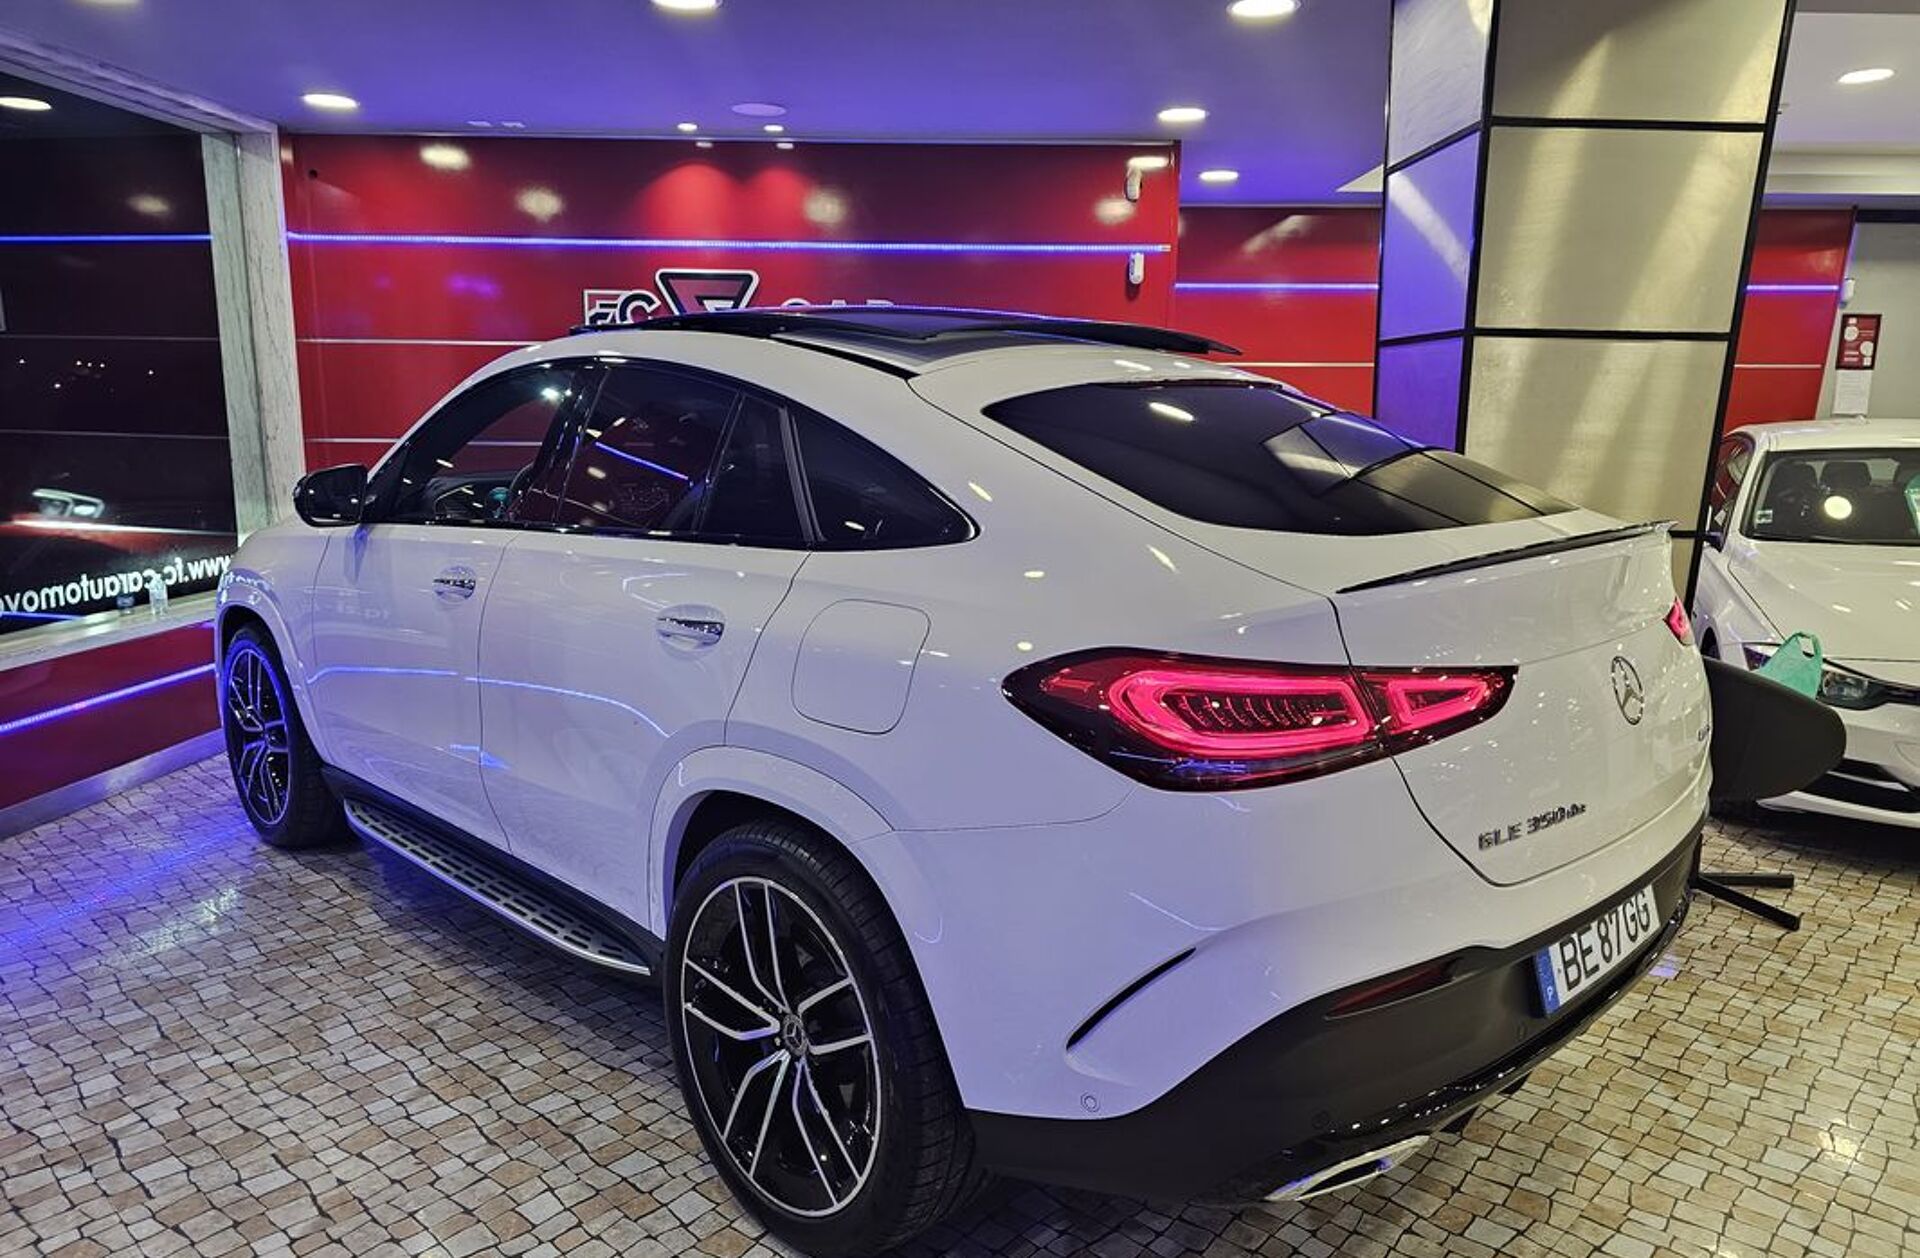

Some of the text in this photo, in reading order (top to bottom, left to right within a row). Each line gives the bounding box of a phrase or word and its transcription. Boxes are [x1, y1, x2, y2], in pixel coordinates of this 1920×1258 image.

[1478, 822, 1522, 850] GLE
[1559, 890, 1651, 991] BE 87 GG
